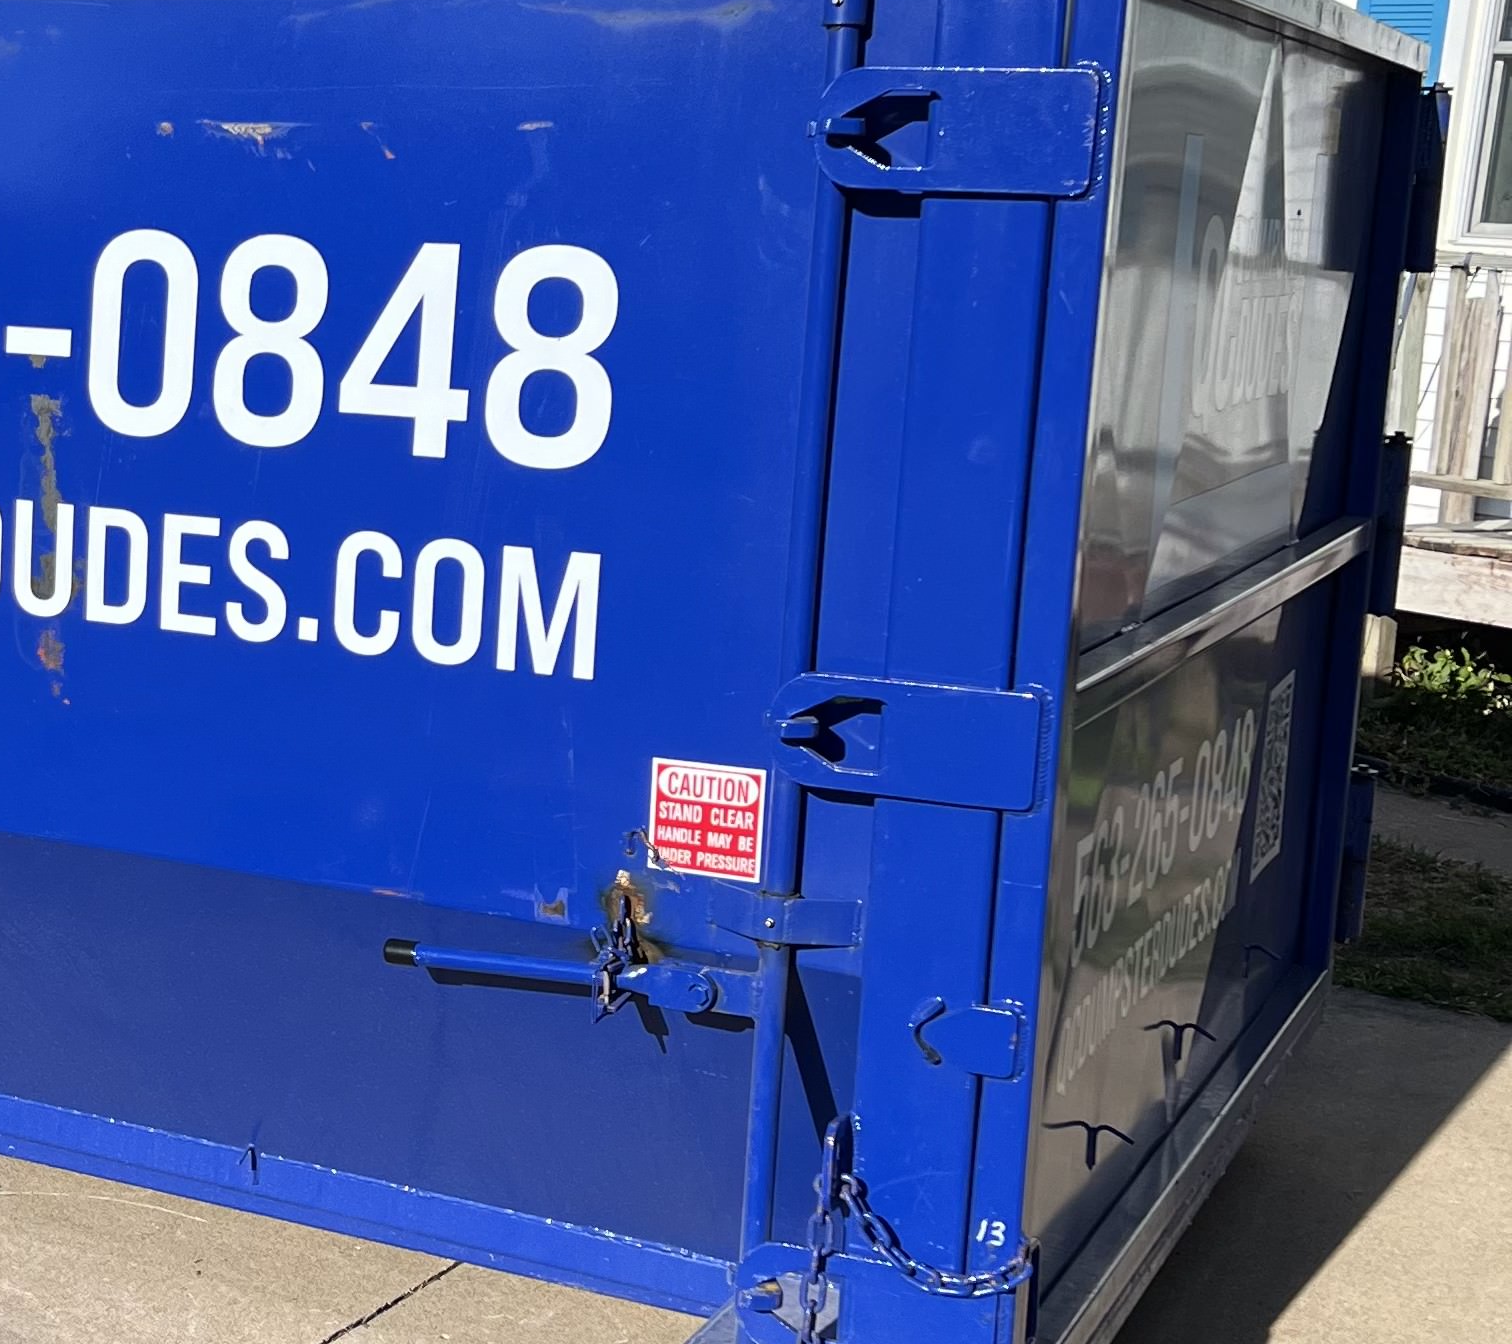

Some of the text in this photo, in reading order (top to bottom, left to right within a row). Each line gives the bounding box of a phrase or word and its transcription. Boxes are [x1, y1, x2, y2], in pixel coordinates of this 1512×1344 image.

[668, 772, 749, 804] CAUTION
[658, 801, 755, 831] STAND CLEAR
[656, 825, 754, 853] HANDLE MAY BE
[1071, 708, 1255, 969] 563-265-0848
[696, 851, 755, 875] PRESSURE
[975, 1218, 1006, 1247] 13
